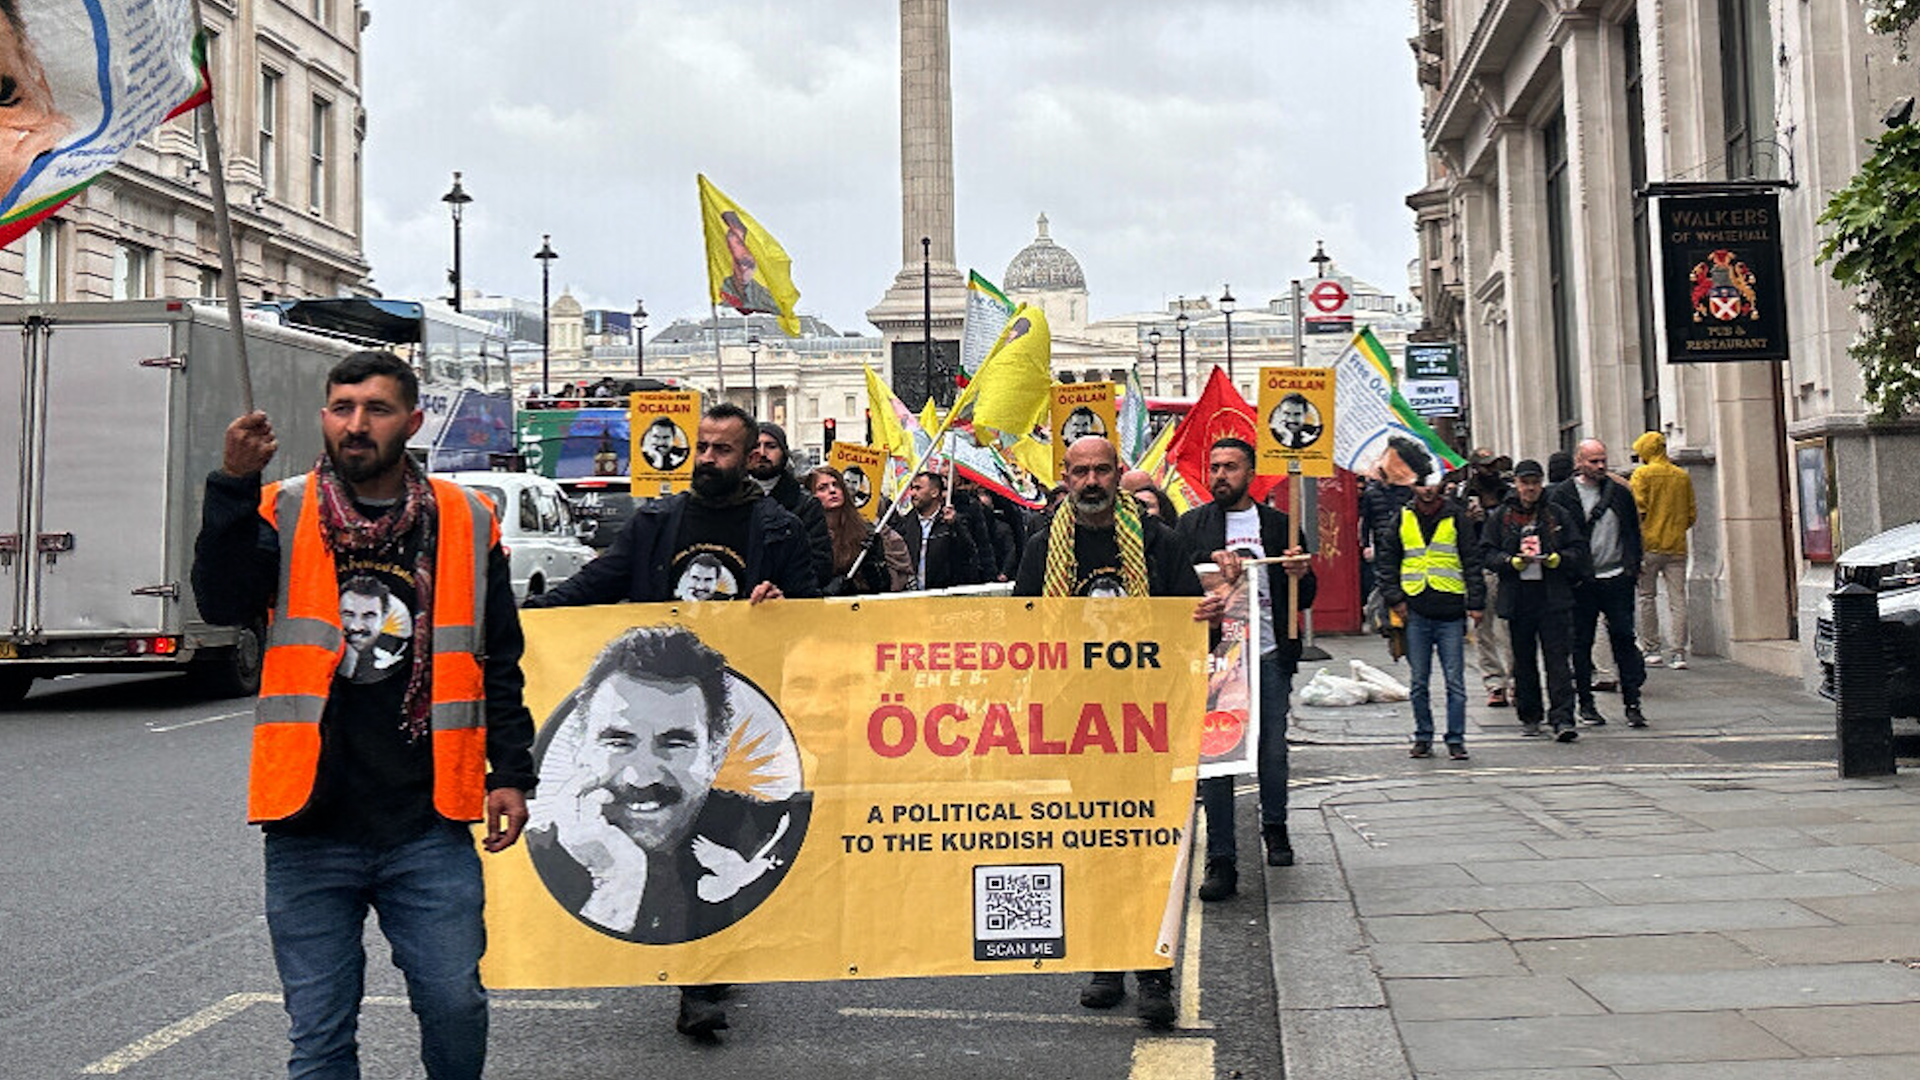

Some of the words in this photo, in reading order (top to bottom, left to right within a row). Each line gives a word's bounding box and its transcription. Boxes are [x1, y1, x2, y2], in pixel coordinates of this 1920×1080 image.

[1671, 208, 1769, 227] WALKERS
[1672, 231, 1690, 243] OF
[1695, 230, 1770, 242] WHITEHALL
[1707, 326, 1732, 336] PUB
[1735, 326, 1746, 336] &
[1686, 338, 1768, 350] RESTAURANT
[1350, 354, 1370, 382] Free
[875, 641, 1068, 672] FREEDOM
[1083, 640, 1162, 669] FOR
[867, 692, 1170, 758] ÖCALAN
[867, 806, 884, 824] A
[892, 802, 1023, 823] POLITICAL
[1031, 800, 1156, 821] SOLUTION
[841, 835, 874, 853] TO
[884, 834, 933, 852] THE
[941, 831, 1053, 851] KURDISH
[986, 943, 1027, 956] SCAN
[1030, 943, 1053, 955] ME
